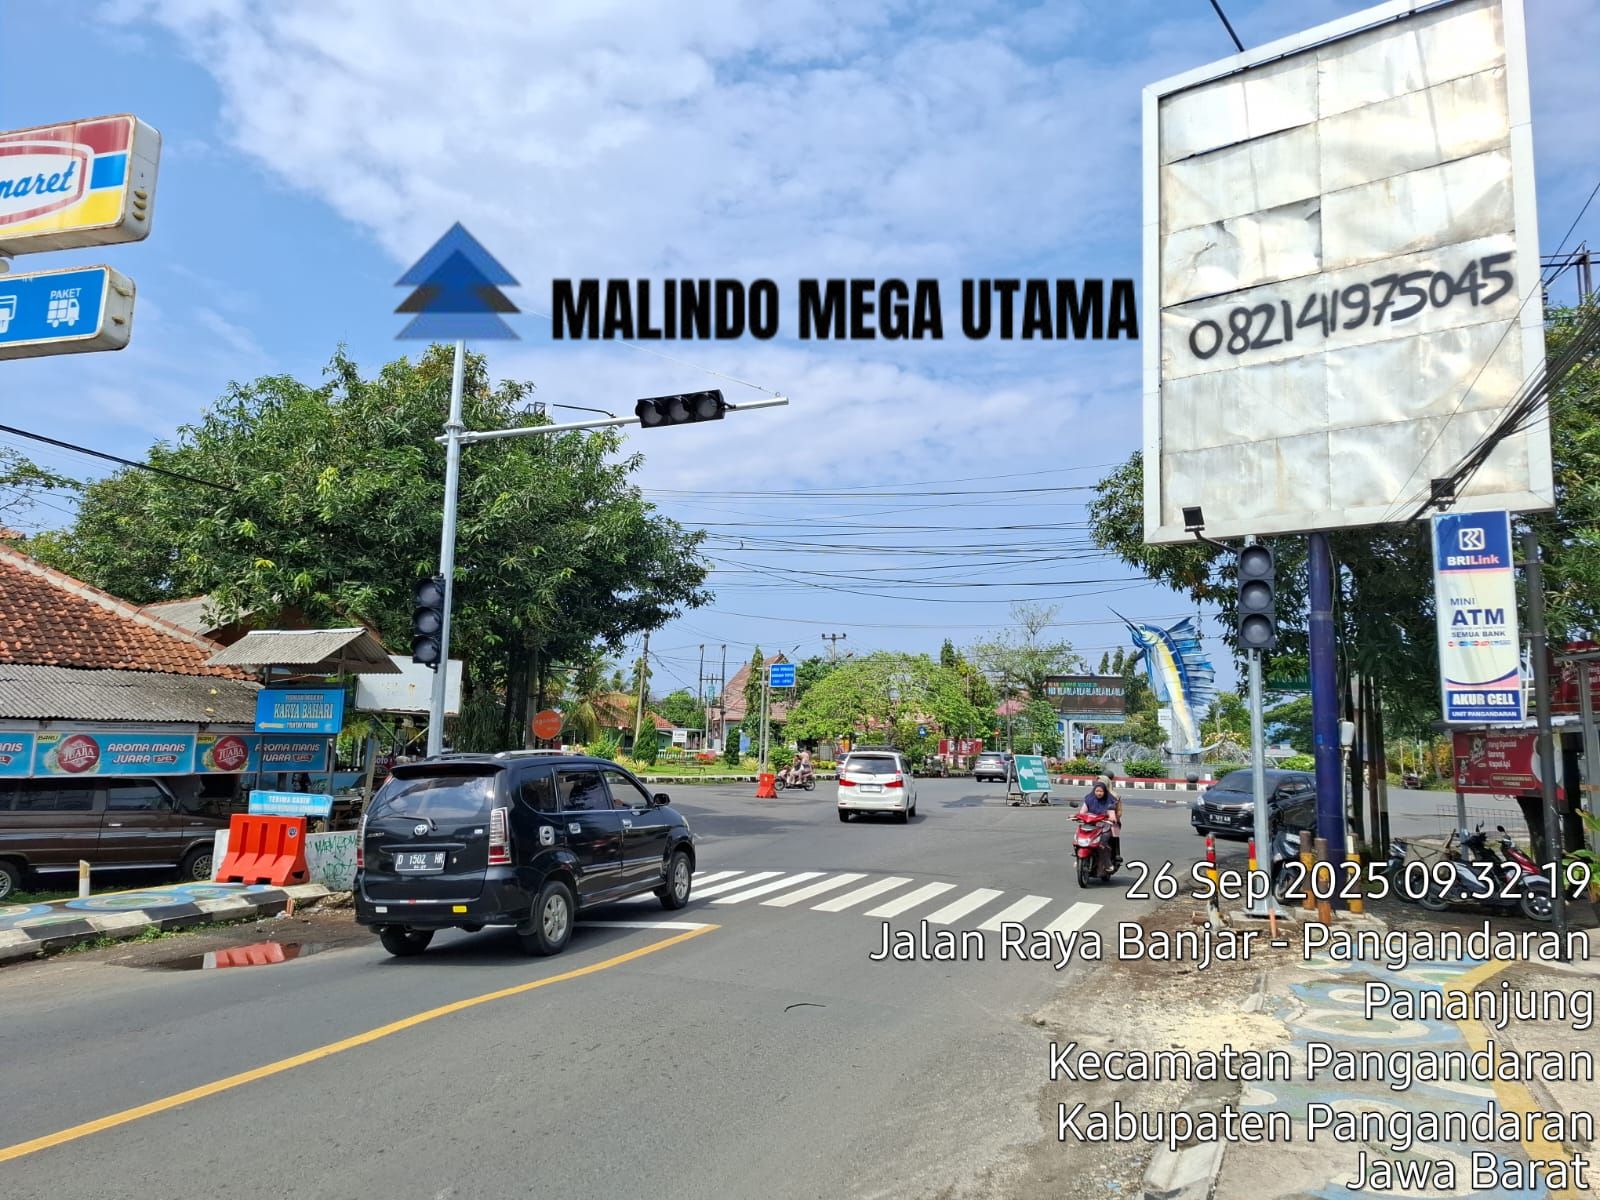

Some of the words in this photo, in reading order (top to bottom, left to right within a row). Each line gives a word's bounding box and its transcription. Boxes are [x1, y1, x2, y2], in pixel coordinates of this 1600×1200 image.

[50, 287, 82, 300] PAKET
[1188, 250, 1516, 360] 082141975045
[1446, 553, 1500, 567] BRILink
[1450, 597, 1475, 606] MINI
[1451, 607, 1505, 626] ATM
[1482, 630, 1506, 638] BANK
[1452, 692, 1486, 706] AKUR
[1487, 692, 1516, 706] CELL
[273, 702, 300, 719] KARYA
[302, 702, 334, 719] BAHARI
[107, 743, 150, 752] AROMA
[151, 743, 186, 752] MANIS
[218, 747, 244, 761] JUARA
[291, 743, 320, 752] MANIS
[112, 755, 151, 763] JUARA
[397, 854, 404, 865] D
[410, 854, 426, 865] 1502
